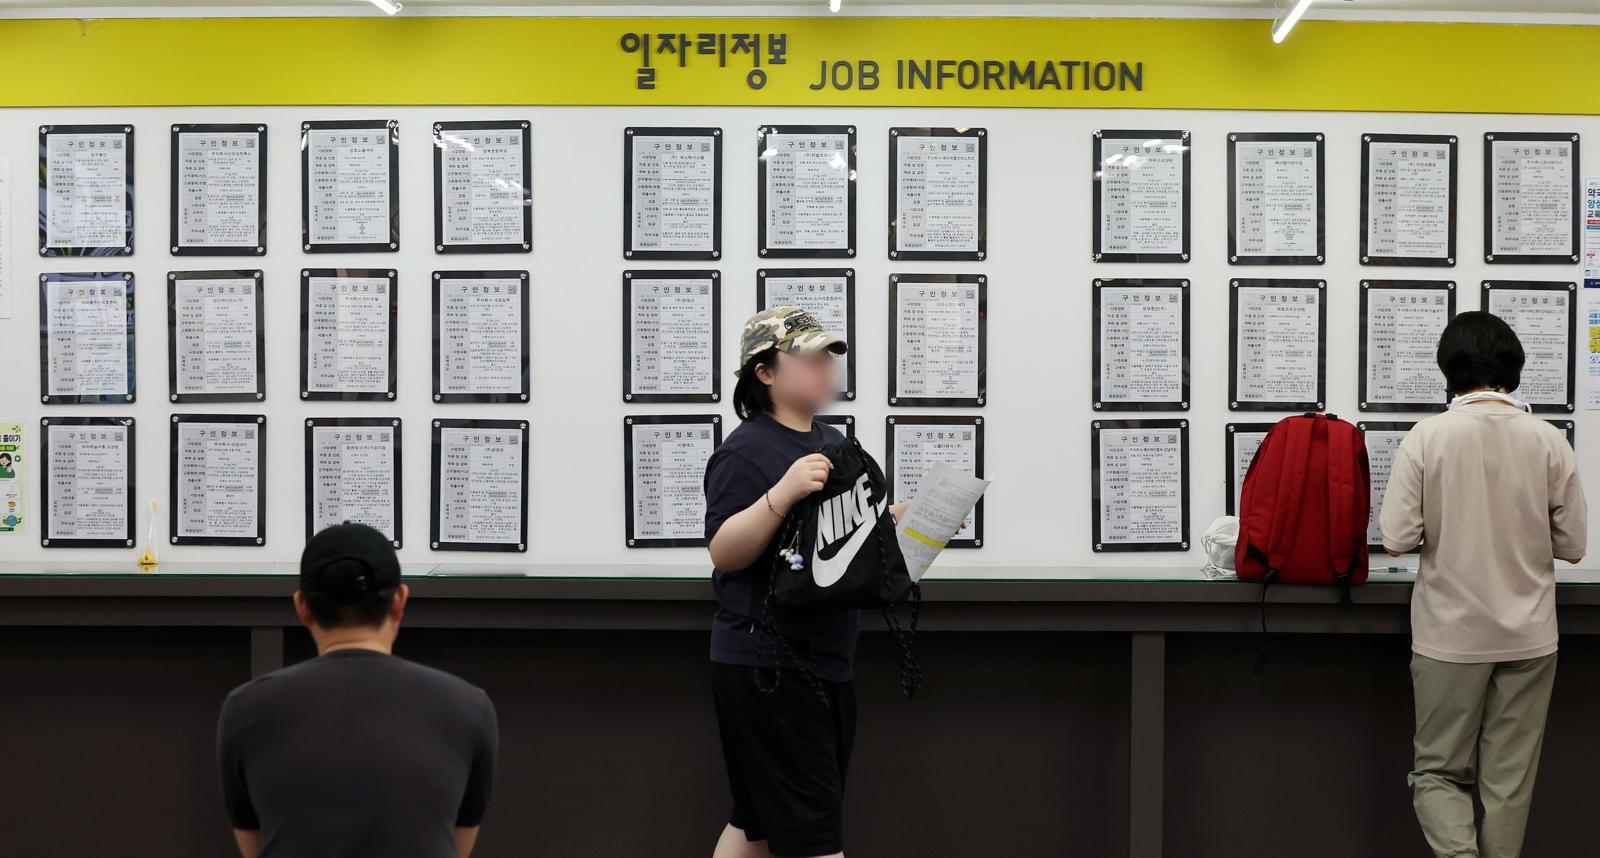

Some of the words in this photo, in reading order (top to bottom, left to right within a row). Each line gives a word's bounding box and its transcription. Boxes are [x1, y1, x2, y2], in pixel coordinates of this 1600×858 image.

[620, 33, 787, 90] 일자리정보
[810, 60, 879, 91] JOB
[897, 60, 1143, 92] INFORMATION
[200, 139, 238, 147] 구인정보
[329, 136, 369, 144] 구인정보
[67, 141, 106, 149] 구인정보
[653, 143, 694, 151] 구인정보
[787, 141, 827, 149] 구인정보
[919, 144, 959, 152] 구인정보
[1122, 146, 1162, 154] 구인정보
[1256, 148, 1296, 157] 구인정보
[1390, 150, 1429, 158] 구인정보
[1513, 148, 1551, 156] 구인정보
[67, 288, 107, 296] 구인정보
[196, 286, 235, 294] 구인정보
[330, 284, 369, 292] 구인정보
[461, 286, 501, 294] 구인정보
[652, 286, 692, 294] 구인정보
[786, 284, 826, 292] 구인정보
[919, 290, 958, 298] 구인정보
[1122, 294, 1161, 302] 구인정보
[1259, 294, 1299, 303] 구인정보
[1389, 296, 1428, 304] 구인정보
[1511, 296, 1549, 305] 구인정보
[69, 432, 107, 441] 구인정보
[199, 430, 238, 438] 구인정보
[334, 433, 373, 441] 구인정보
[654, 431, 694, 439] 구인정보
[915, 432, 955, 440] 구인정보
[463, 435, 501, 443] 구인정보
[817, 473, 873, 552] NIKE
